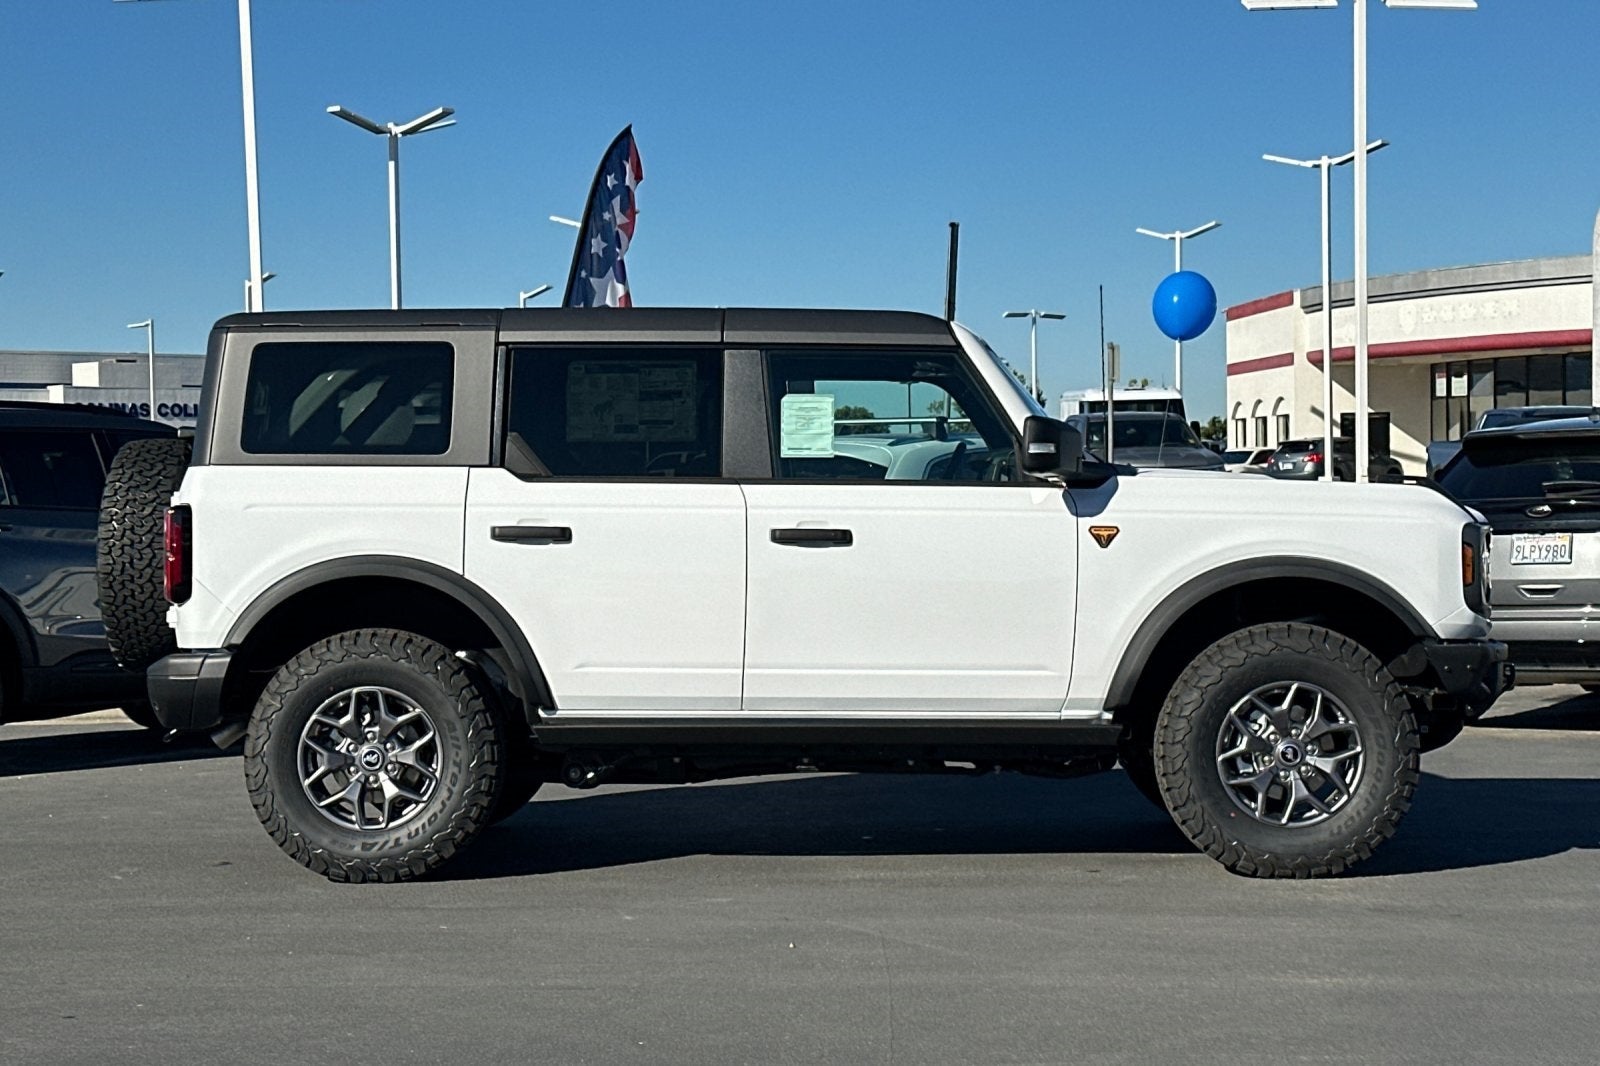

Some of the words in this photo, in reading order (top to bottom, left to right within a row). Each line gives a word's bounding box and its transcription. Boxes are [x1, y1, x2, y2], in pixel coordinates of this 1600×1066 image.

[1515, 544, 1566, 560] 9LPY980
[407, 718, 463, 840] All-Terrain
[361, 836, 404, 852] T/A
